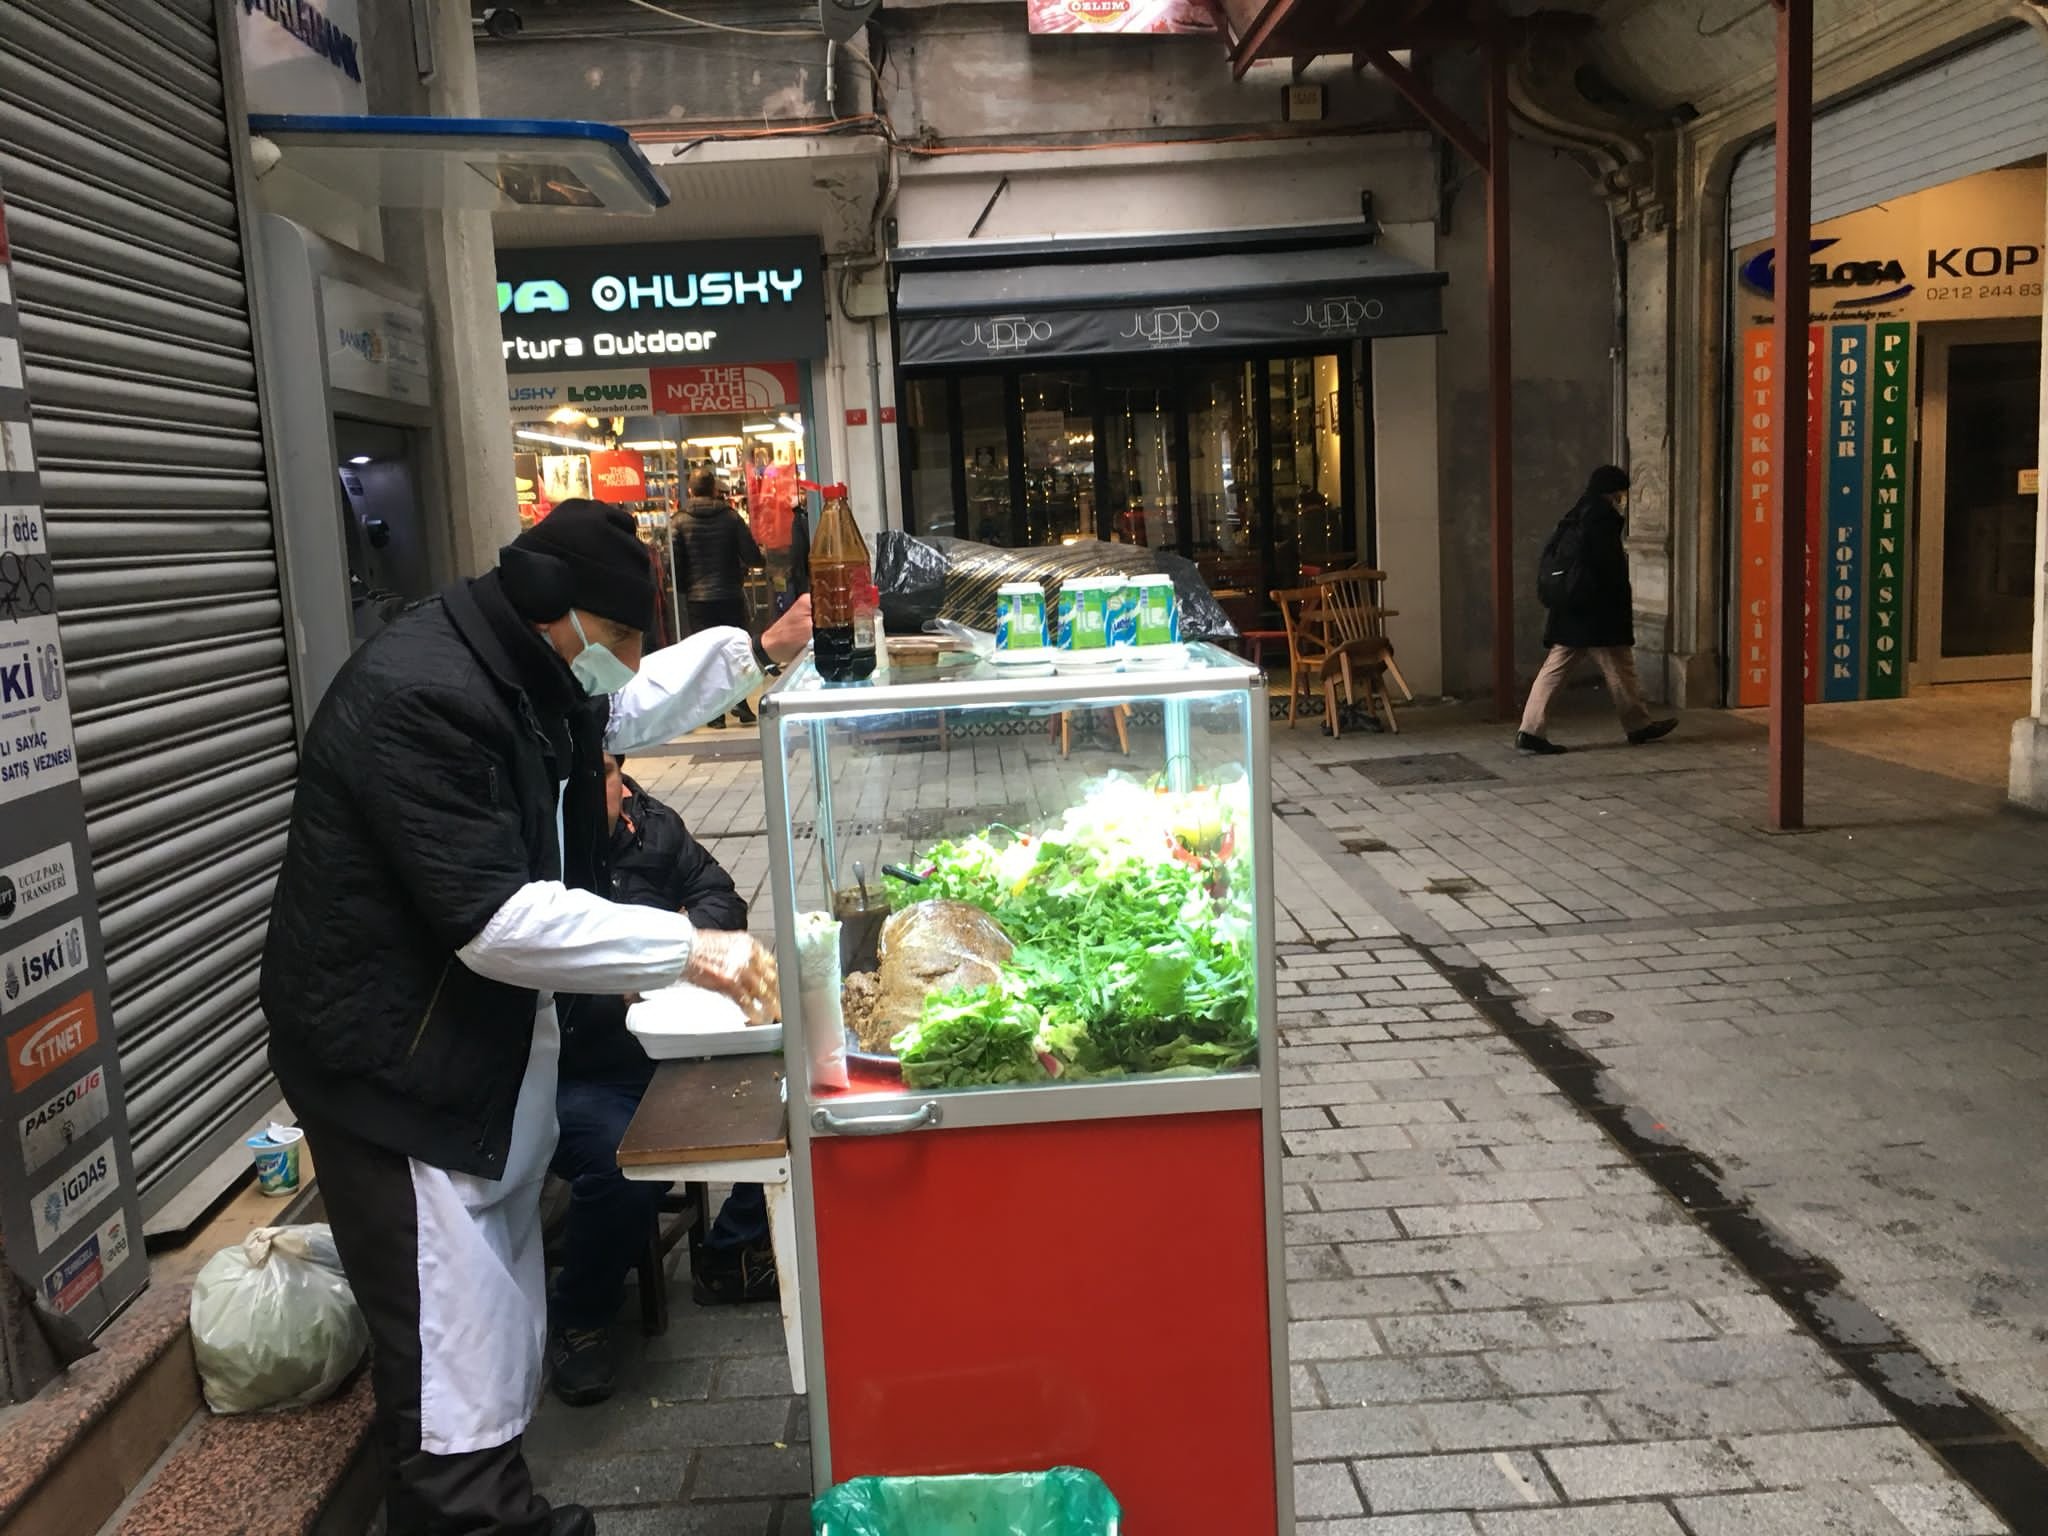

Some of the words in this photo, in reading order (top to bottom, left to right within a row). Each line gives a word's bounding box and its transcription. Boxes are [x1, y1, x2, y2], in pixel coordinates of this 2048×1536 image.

[1927, 245, 2045, 278] KOP
[628, 268, 803, 309] HUSKY
[1926, 286, 1973, 300] 0212
[1979, 284, 2013, 298] 244
[502, 336, 584, 359] rtura
[594, 330, 718, 357] Outdoor
[701, 367, 742, 384] THE
[1882, 335, 1901, 402] PVC
[567, 383, 648, 402] LOWA
[666, 380, 744, 399] NORTH
[690, 396, 745, 411] FACE
[1838, 337, 1859, 457] POSTER
[1876, 438, 1898, 676] LAMİNASYON
[1833, 527, 1854, 679] FOTOBLOK
[16, 731, 48, 753] SAYAÇ
[1, 760, 30, 783] SATIŞ
[35, 1020, 83, 1067] TTNET
